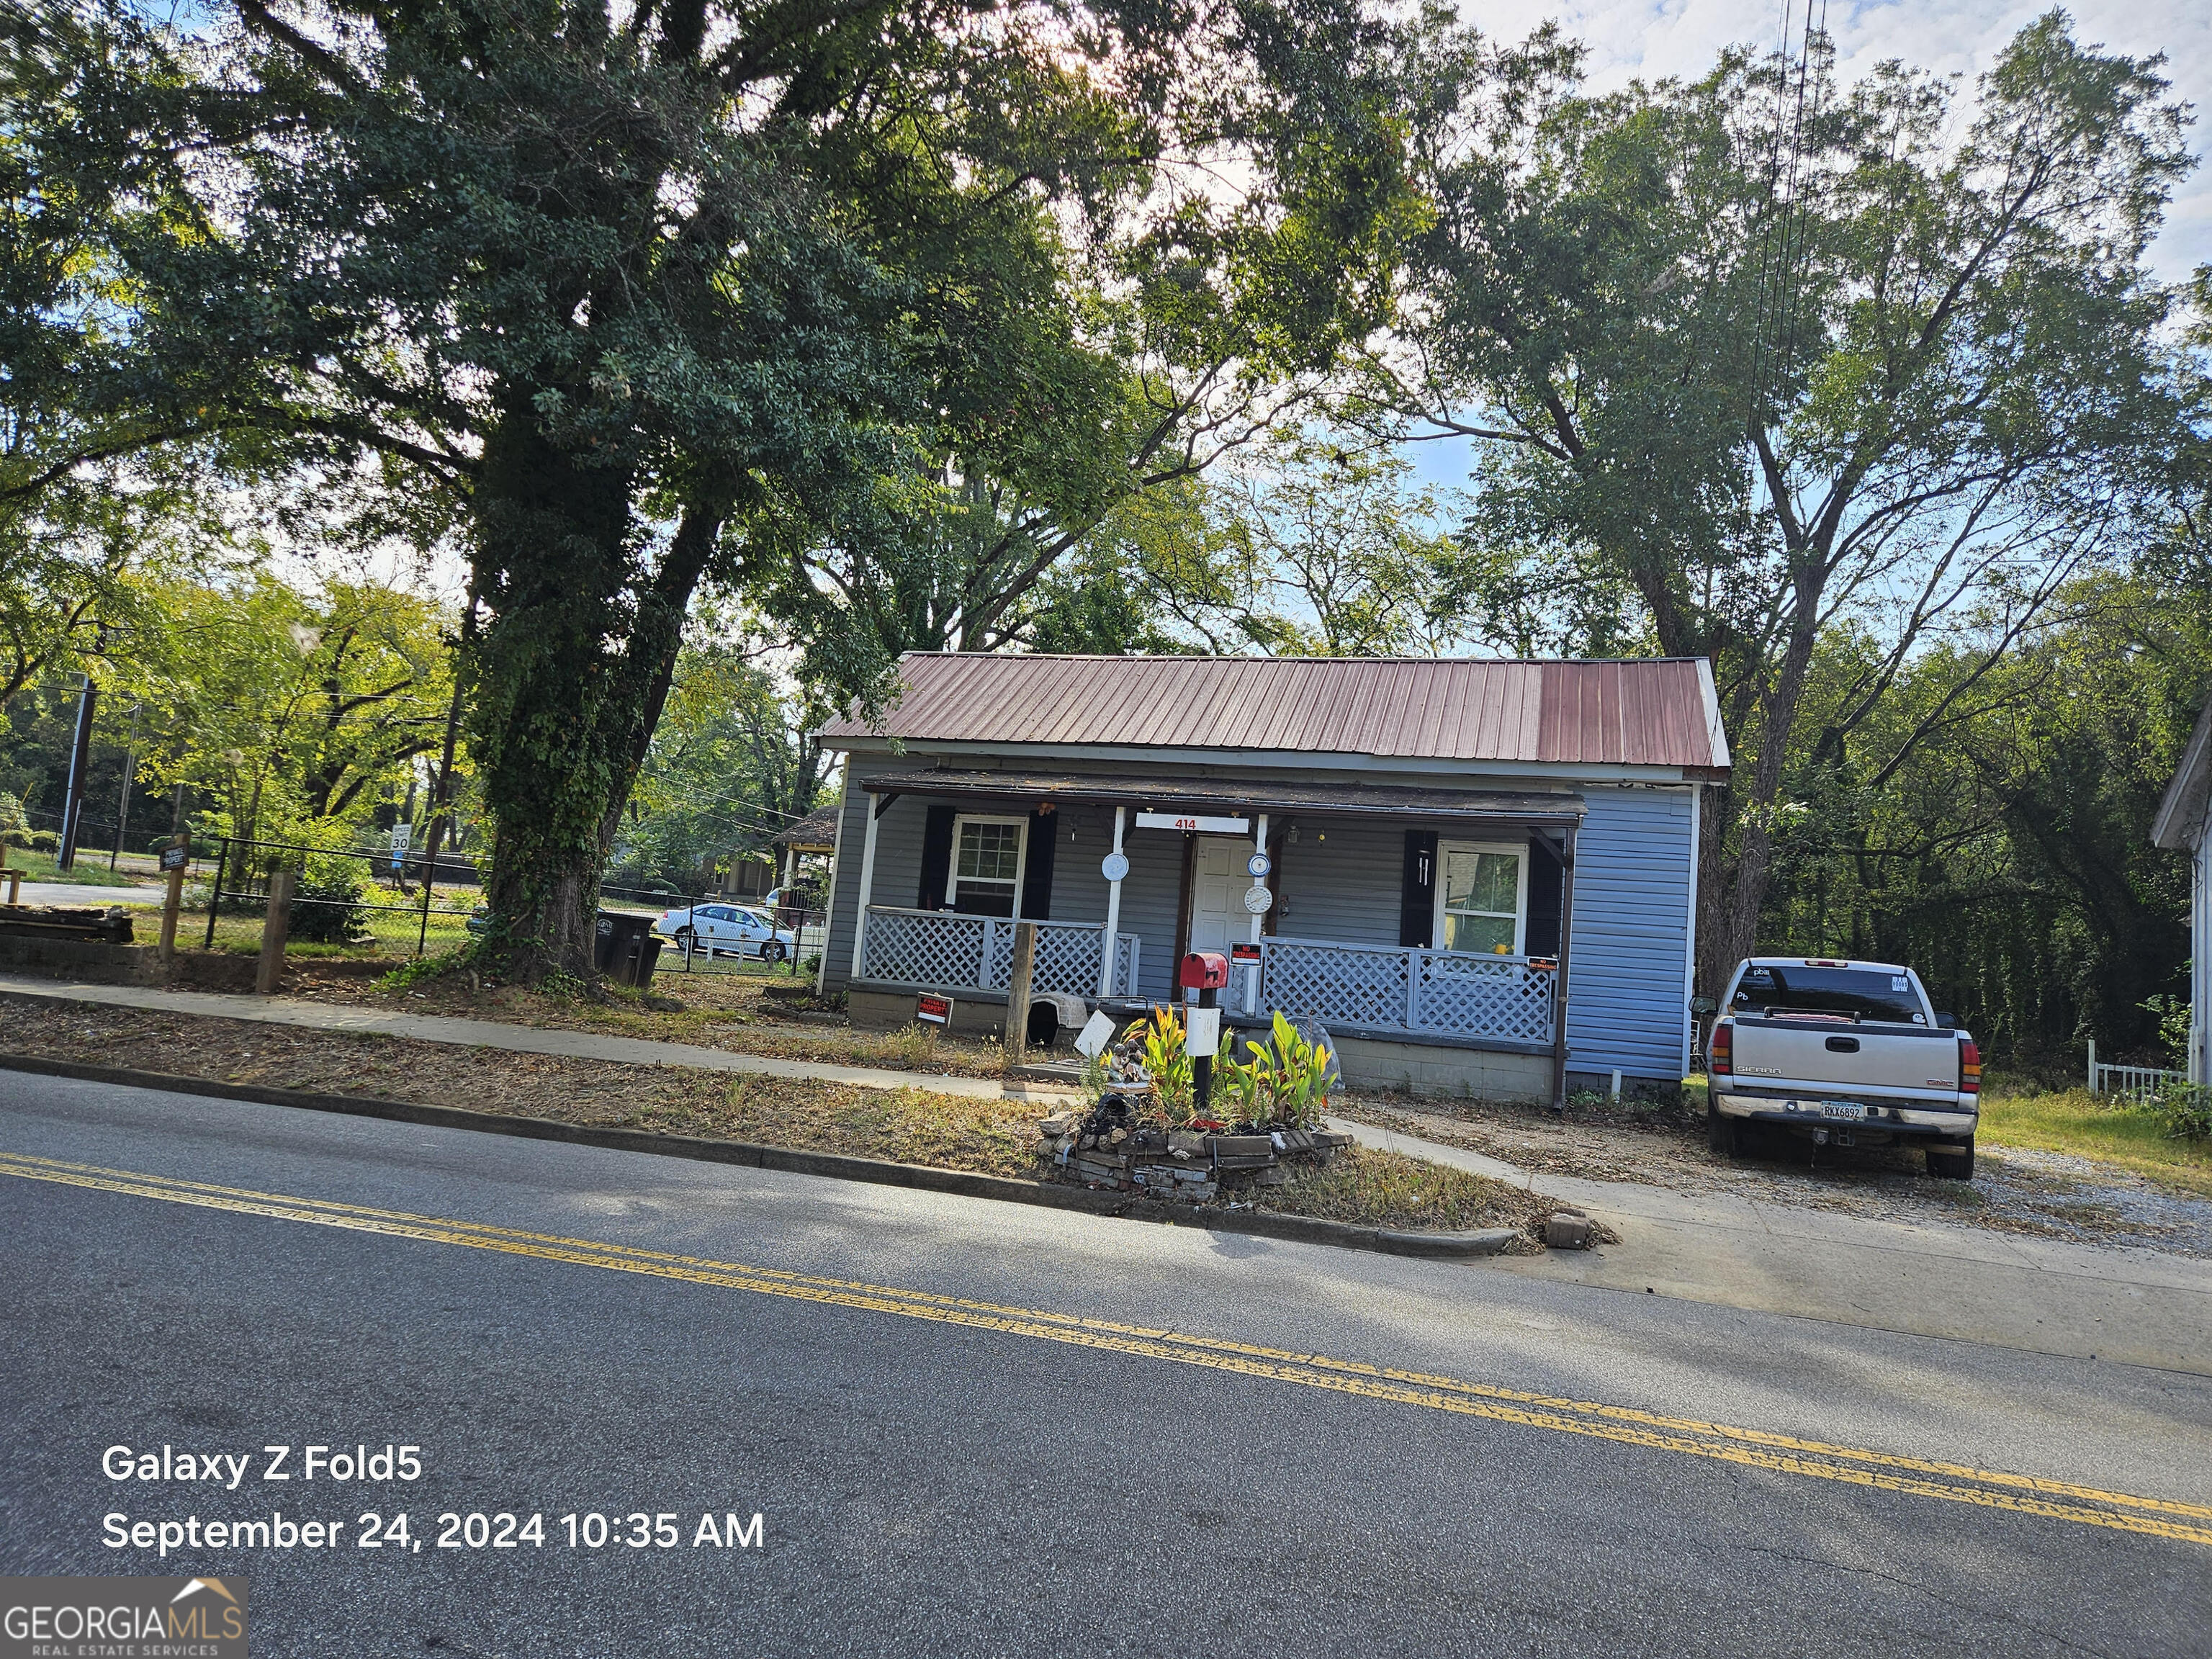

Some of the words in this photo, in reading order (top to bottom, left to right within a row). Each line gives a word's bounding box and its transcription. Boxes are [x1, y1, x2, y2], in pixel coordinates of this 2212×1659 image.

[1175, 819, 1196, 830] 414
[392, 838, 408, 848] 30
[162, 855, 184, 866] PROPERT
[923, 998, 946, 1007] PRIVATE
[1737, 1066, 1781, 1074] SIERRA
[1825, 1106, 1860, 1118] RKX6892
